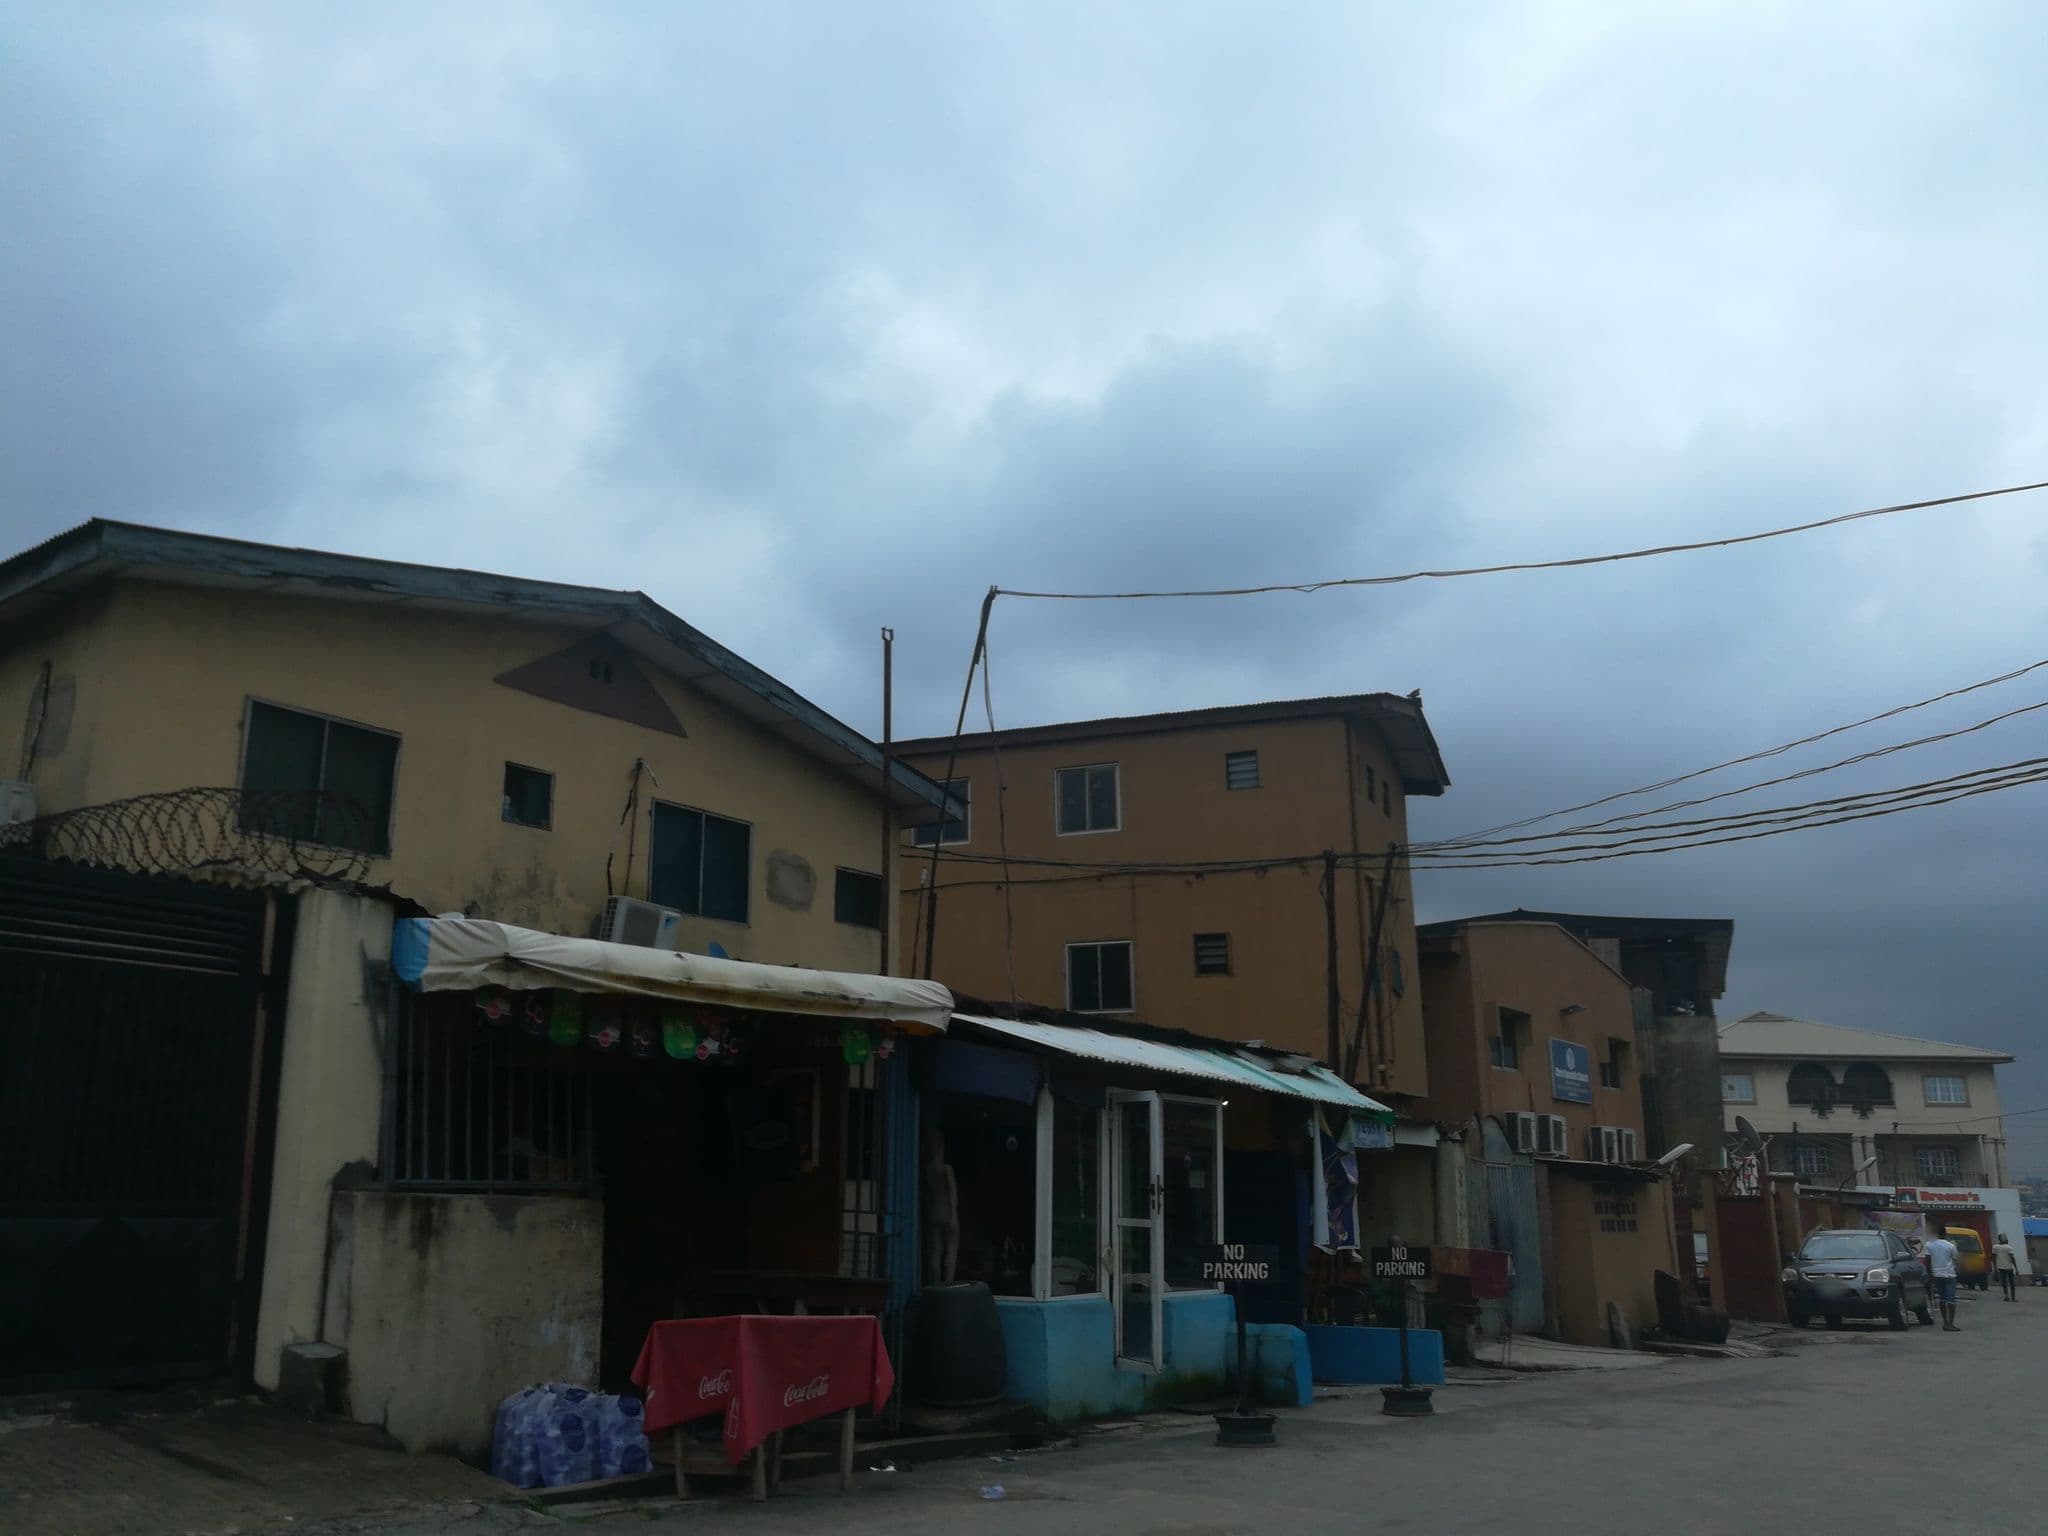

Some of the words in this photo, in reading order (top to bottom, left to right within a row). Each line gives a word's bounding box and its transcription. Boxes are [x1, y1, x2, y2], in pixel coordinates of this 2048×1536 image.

[1223, 1244, 1245, 1260] NO
[1391, 1246, 1408, 1260] NO
[1203, 1262, 1269, 1279] PARKING
[1376, 1262, 1425, 1276] PARKING
